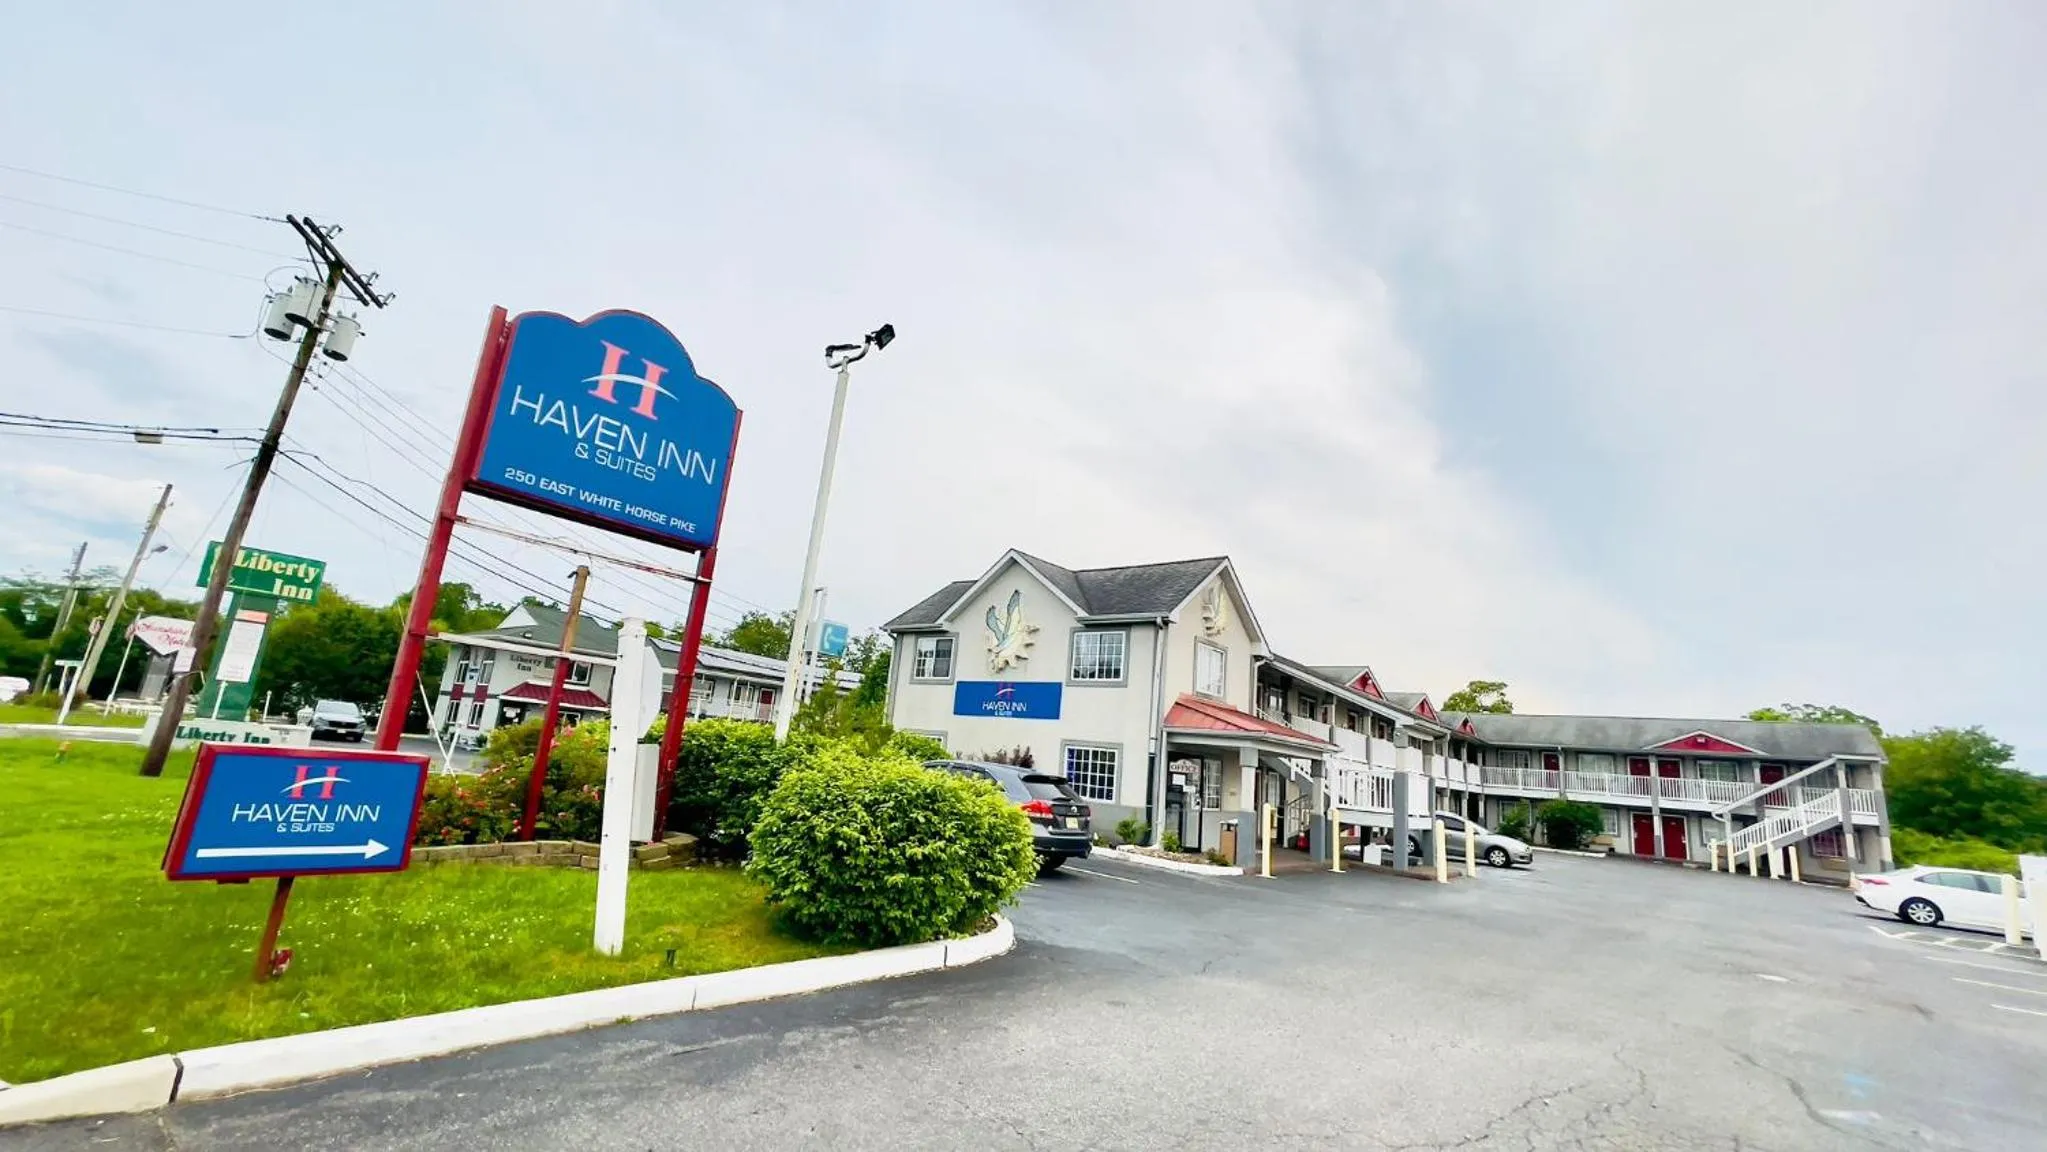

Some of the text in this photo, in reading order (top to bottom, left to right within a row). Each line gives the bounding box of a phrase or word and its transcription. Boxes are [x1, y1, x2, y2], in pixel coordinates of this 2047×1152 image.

[510, 384, 716, 485] HAVEN INN
[574, 442, 657, 482] & SUITES
[504, 467, 697, 534] 250 EAST WHITE HORSE PIKE
[234, 549, 320, 584] Liberty
[272, 578, 314, 600] Inn
[982, 701, 1027, 712] HAVEN INN
[175, 726, 237, 742] Liberty
[243, 732, 271, 744] Inn
[231, 803, 381, 822] HAVEN INN
[276, 822, 336, 833] & SUITES
